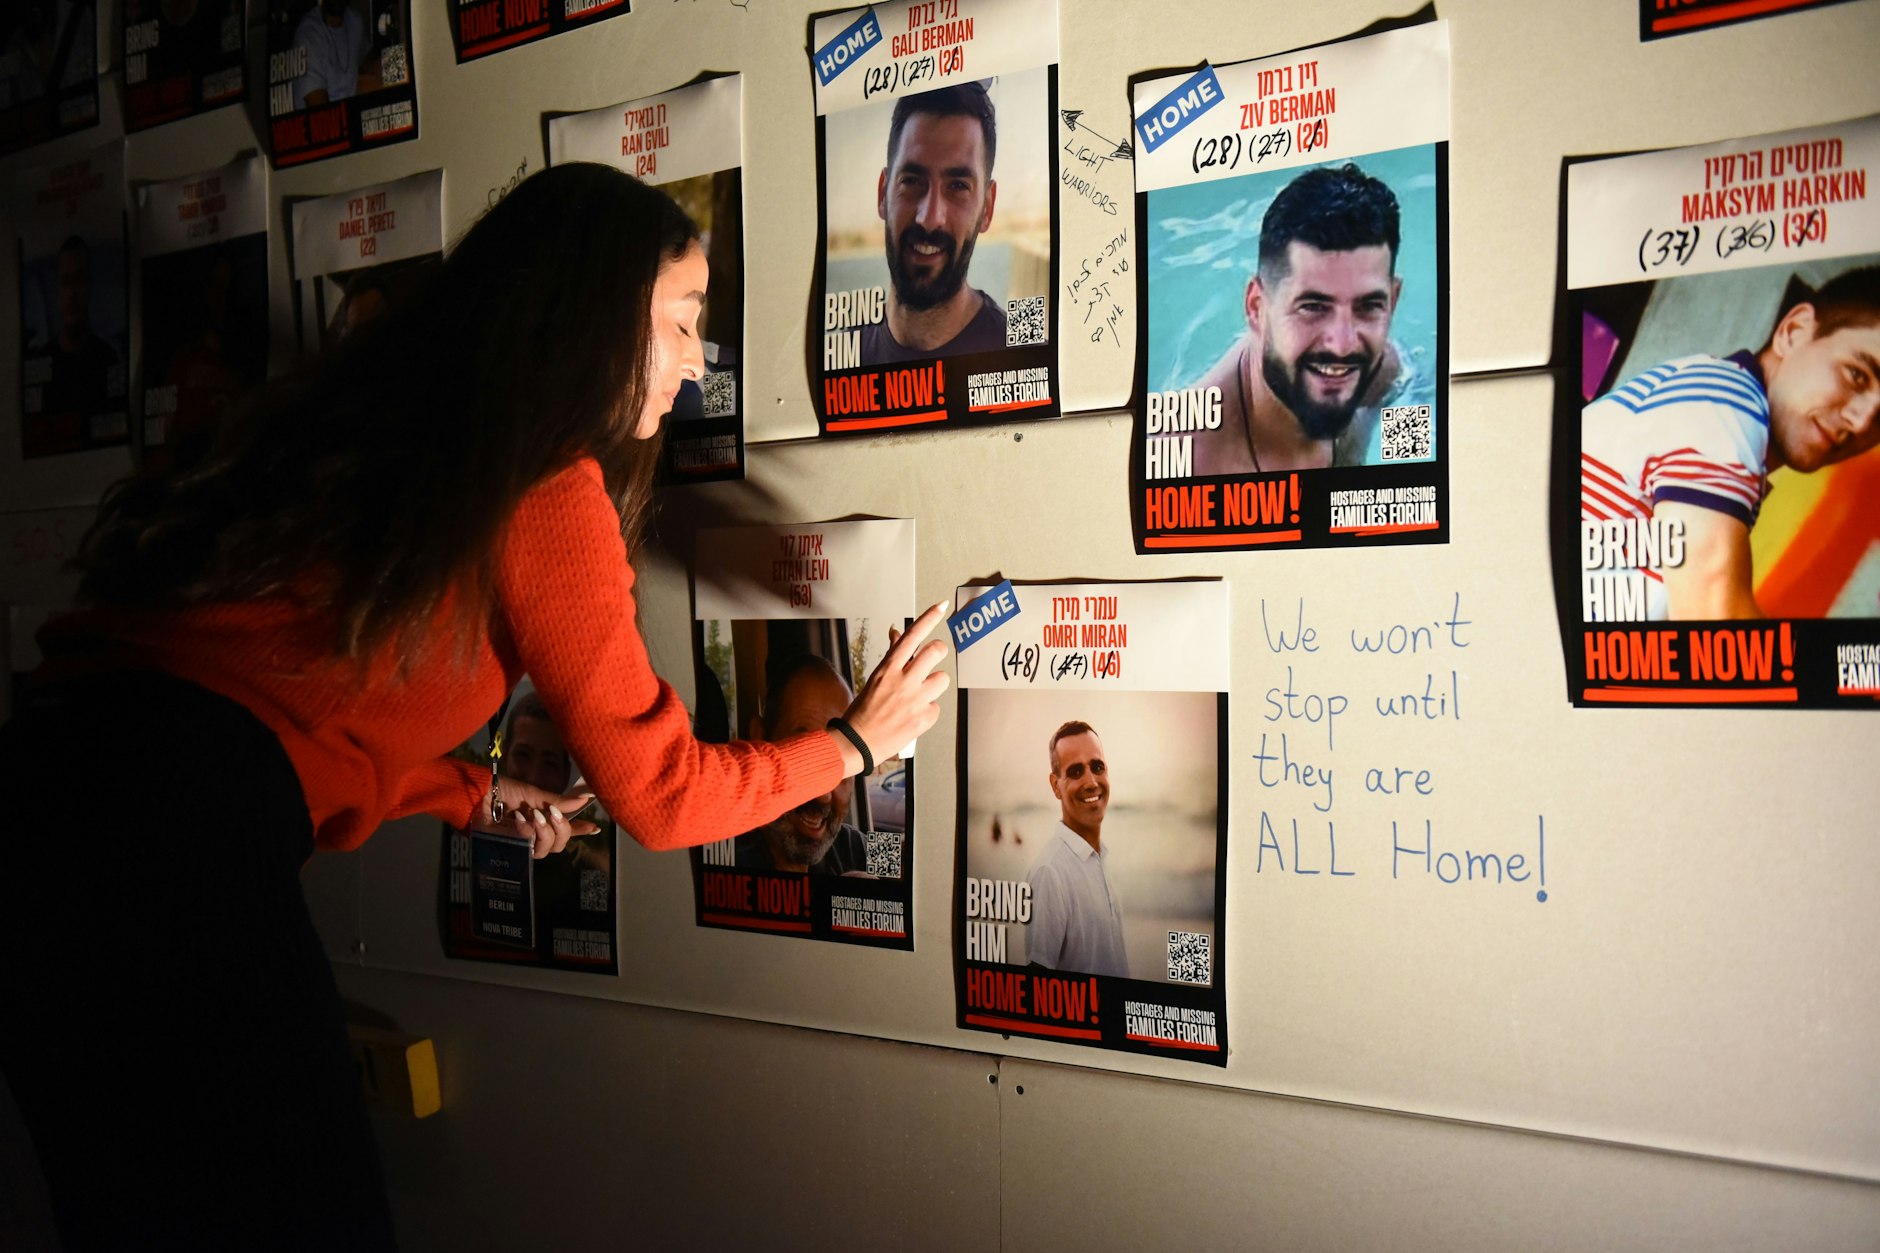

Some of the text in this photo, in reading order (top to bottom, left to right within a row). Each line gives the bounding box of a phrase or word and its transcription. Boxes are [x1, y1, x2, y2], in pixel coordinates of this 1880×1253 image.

[460, 2, 501, 44] HOME
[908, 1, 936, 31] ברמן
[819, 20, 878, 77] HOME
[892, 18, 974, 58] GALI BERMAN
[270, 46, 308, 84] BRING
[864, 62, 899, 100] (28)
[938, 45, 964, 76] (26)
[1257, 61, 1318, 100] זיו ברמן
[270, 81, 294, 117] HIM
[1144, 78, 1218, 143] HOME
[1240, 88, 1336, 130] ZIV BERMAN
[622, 126, 669, 156] RAN GVILI
[1064, 138, 1114, 174] LIGHT
[1192, 133, 1241, 174] (28)
[1297, 117, 1328, 153] (26)
[636, 151, 656, 178] (24)
[1704, 137, 1842, 189] מקסים הרקין
[1061, 167, 1118, 216] WARRIORS
[1682, 169, 1866, 224] MAKSYM HARKIN
[339, 210, 396, 240] DANIEL PERETZ
[360, 236, 376, 258] (22)
[1639, 225, 1700, 272] (37)
[825, 285, 885, 331] BRING
[824, 331, 860, 371] HIM
[824, 360, 946, 416] HOME NOW!
[967, 366, 1049, 389] HOSTAGES AND MISSING
[968, 379, 1050, 408] FAMILIES FORUM
[1147, 386, 1222, 434] BRING
[708, 446, 737, 466] FORUM
[1146, 435, 1192, 480] HIM
[1146, 473, 1302, 530] HOME NOW!
[1330, 486, 1436, 507] HOSTAGES AND MISSING
[1330, 501, 1437, 528] FAMILIES FORUM
[780, 534, 823, 558] איתן לוי
[1581, 517, 1685, 570] BRING
[772, 559, 829, 582] EITAN LEVI
[790, 583, 812, 608] (53)
[1052, 596, 1118, 623] עמרי מירן
[1582, 573, 1647, 622] HIM
[954, 592, 1015, 644] HOME
[1043, 624, 1127, 648] OMRI MIRAN
[1261, 592, 1473, 653] We won't
[1001, 641, 1040, 683] (48)
[1092, 650, 1121, 679] (46)
[1584, 621, 1796, 682] HOME NOW!
[1838, 663, 1880, 690] FAMI
[1264, 665, 1459, 751] stop until
[1252, 733, 1434, 812] they are
[703, 837, 736, 867] HIM
[1257, 811, 1548, 903] ALL Home!
[488, 899, 514, 912] BERLIN
[703, 870, 812, 918] HOME NOW!
[831, 895, 904, 915] HOSTAGES AND MISSING
[966, 877, 1032, 923] BRING
[501, 925, 523, 938] TRIBE
[831, 908, 905, 933] FAMILIES FORUM
[966, 921, 1007, 964] HIM
[966, 968, 1100, 1025] HOME NOW!
[1124, 1000, 1216, 1026] HOSTAGES AND MISSING
[1125, 1015, 1217, 1047] FAMILIES FORUM
